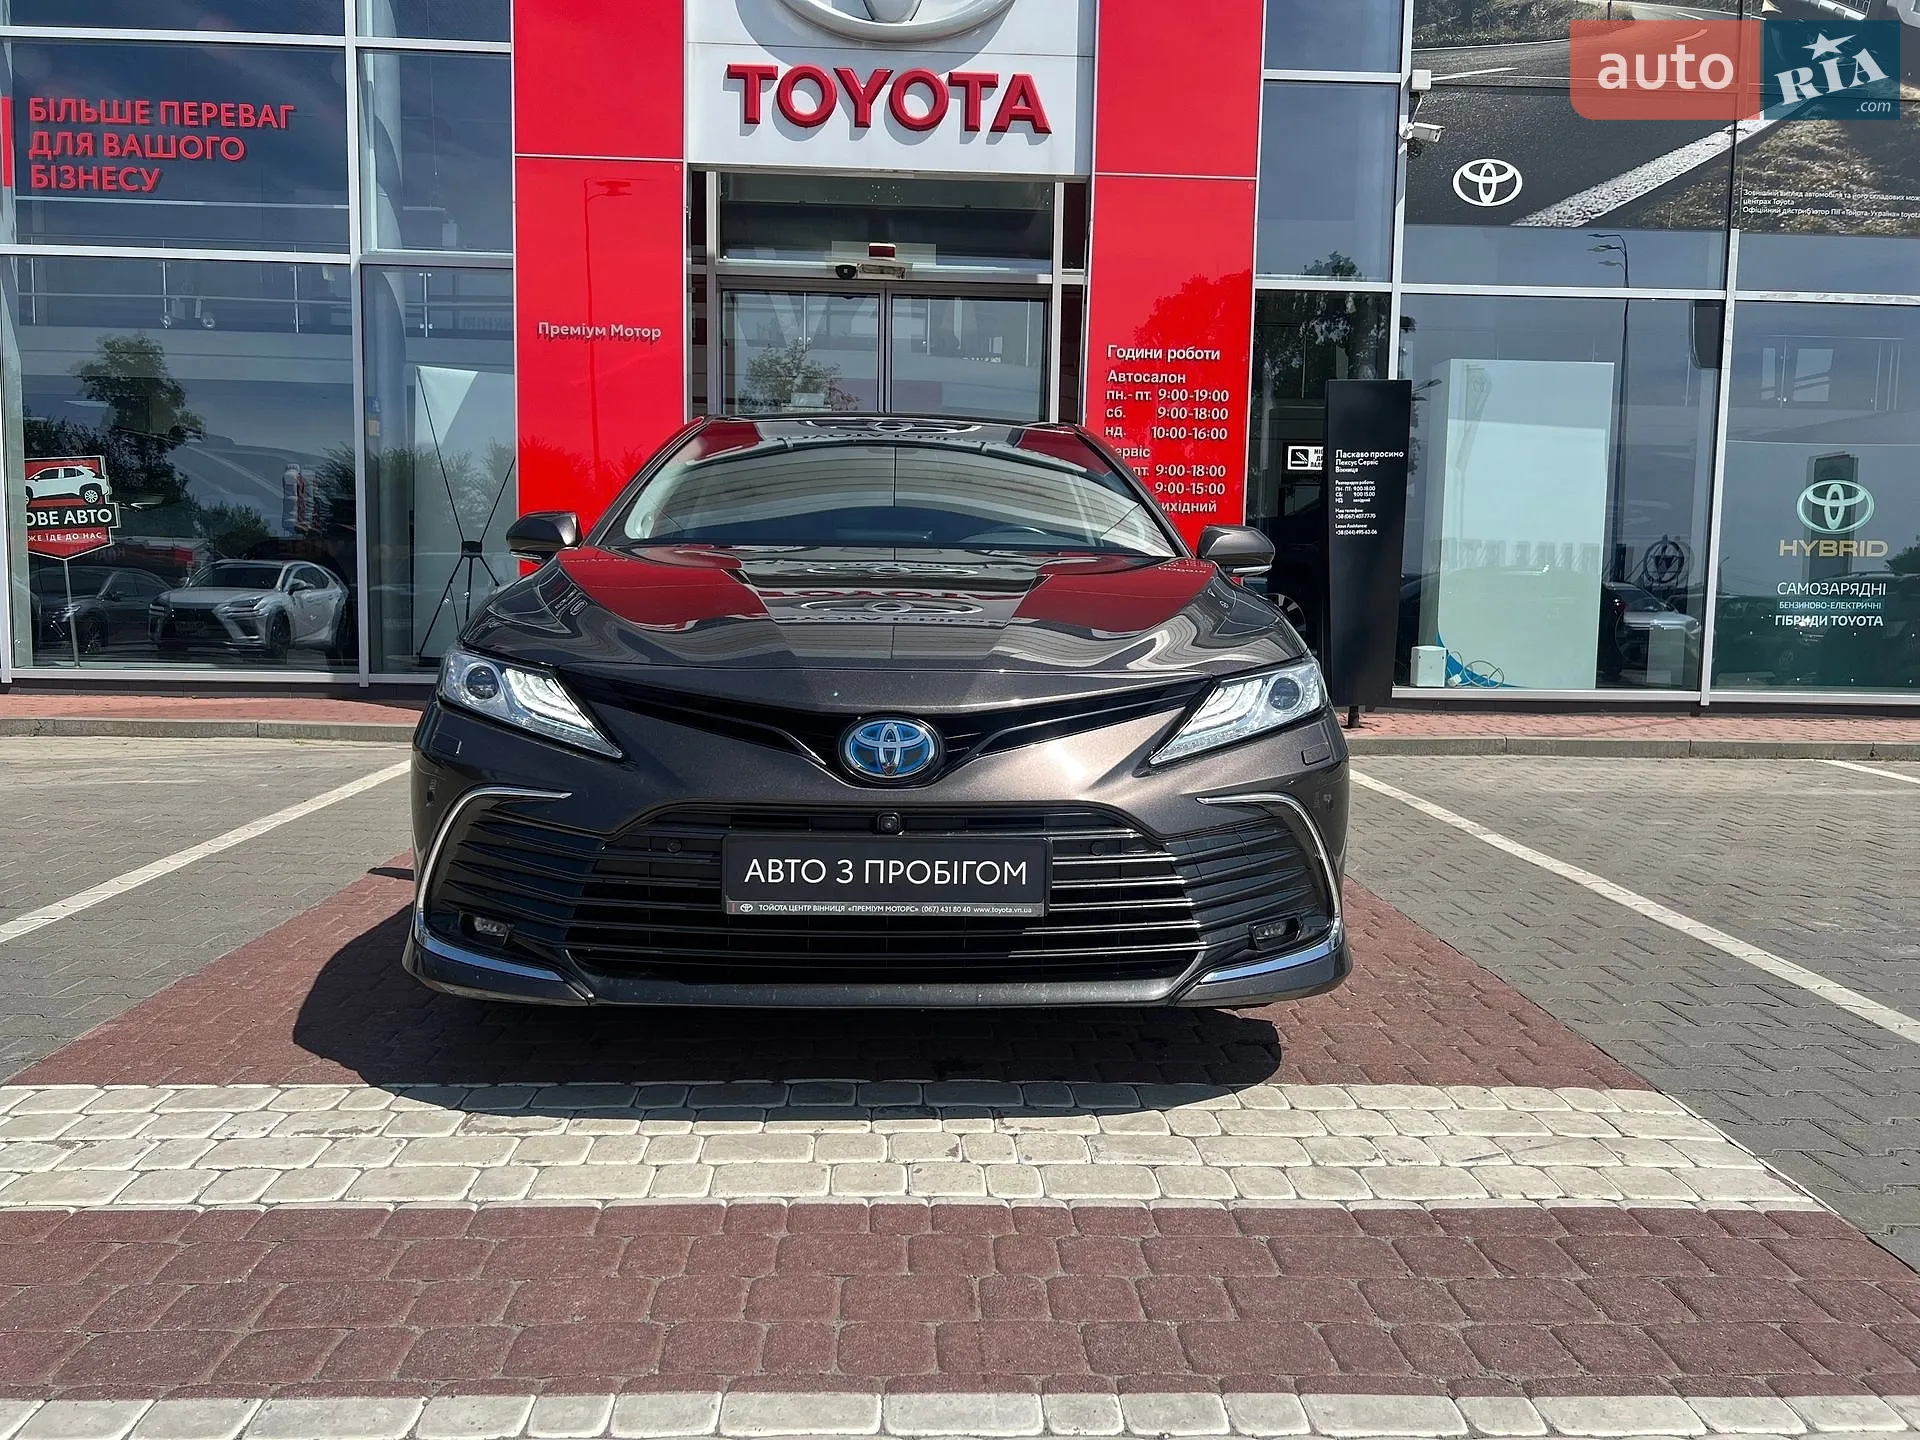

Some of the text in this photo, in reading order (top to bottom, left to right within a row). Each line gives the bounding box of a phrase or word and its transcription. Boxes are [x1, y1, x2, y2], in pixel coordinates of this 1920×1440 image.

[727, 63, 1052, 134] TOYOTA
[29, 97, 295, 129] БІЛЬШЕ ПЕРЕВАГ
[28, 131, 246, 161] ДЛЯ ВАШОГО
[30, 164, 161, 192] БІЗНЕСУ
[1743, 198, 1795, 206] центрах Toyota
[538, 321, 662, 340] Преміум Мотор
[1107, 345, 1221, 362] Години роботи
[1107, 370, 1186, 383] Автосалон
[1158, 389, 1229, 402] 9:00-19:00
[1106, 406, 1229, 420] сб. 9:00-18:00
[1105, 426, 1228, 440] нд. 10:00-16:00
[1113, 445, 1151, 459] ервіс
[1335, 449, 1404, 460] Ласкаво просимо
[1155, 464, 1226, 477] 9:00-18:00
[1154, 482, 1226, 495] 9:00-15:00
[1161, 500, 1217, 514] ихідний
[26, 509, 112, 526] ОВЕ АВТО
[28, 534, 42, 542] ЖЕ
[46, 533, 62, 541] ЇДЕ
[65, 533, 79, 541] ДО
[1779, 539, 1889, 557] HYBRID
[1777, 582, 1886, 597] САМОЗАРЯДНІ
[1779, 601, 1881, 609] БЕНЗИНОВО-ЕЛЕКТРИЧНІ
[1775, 614, 1884, 627] ГІБРИДИ TOYOTA
[744, 858, 1027, 885] АВТО З ПРОБІГОМ
[758, 903, 787, 911] ТОЙОТА
[788, 904, 812, 912] ЦЕНТР
[813, 904, 845, 912] ВІННИЦЯ
[847, 904, 884, 912] «ПРЕМІУМ
[921, 905, 939, 913] (067)
[940, 905, 952, 913] 431
[953, 905, 962, 913] 80
[962, 905, 971, 913] 40
[974, 906, 1032, 915] www.toyota.vn.ua
